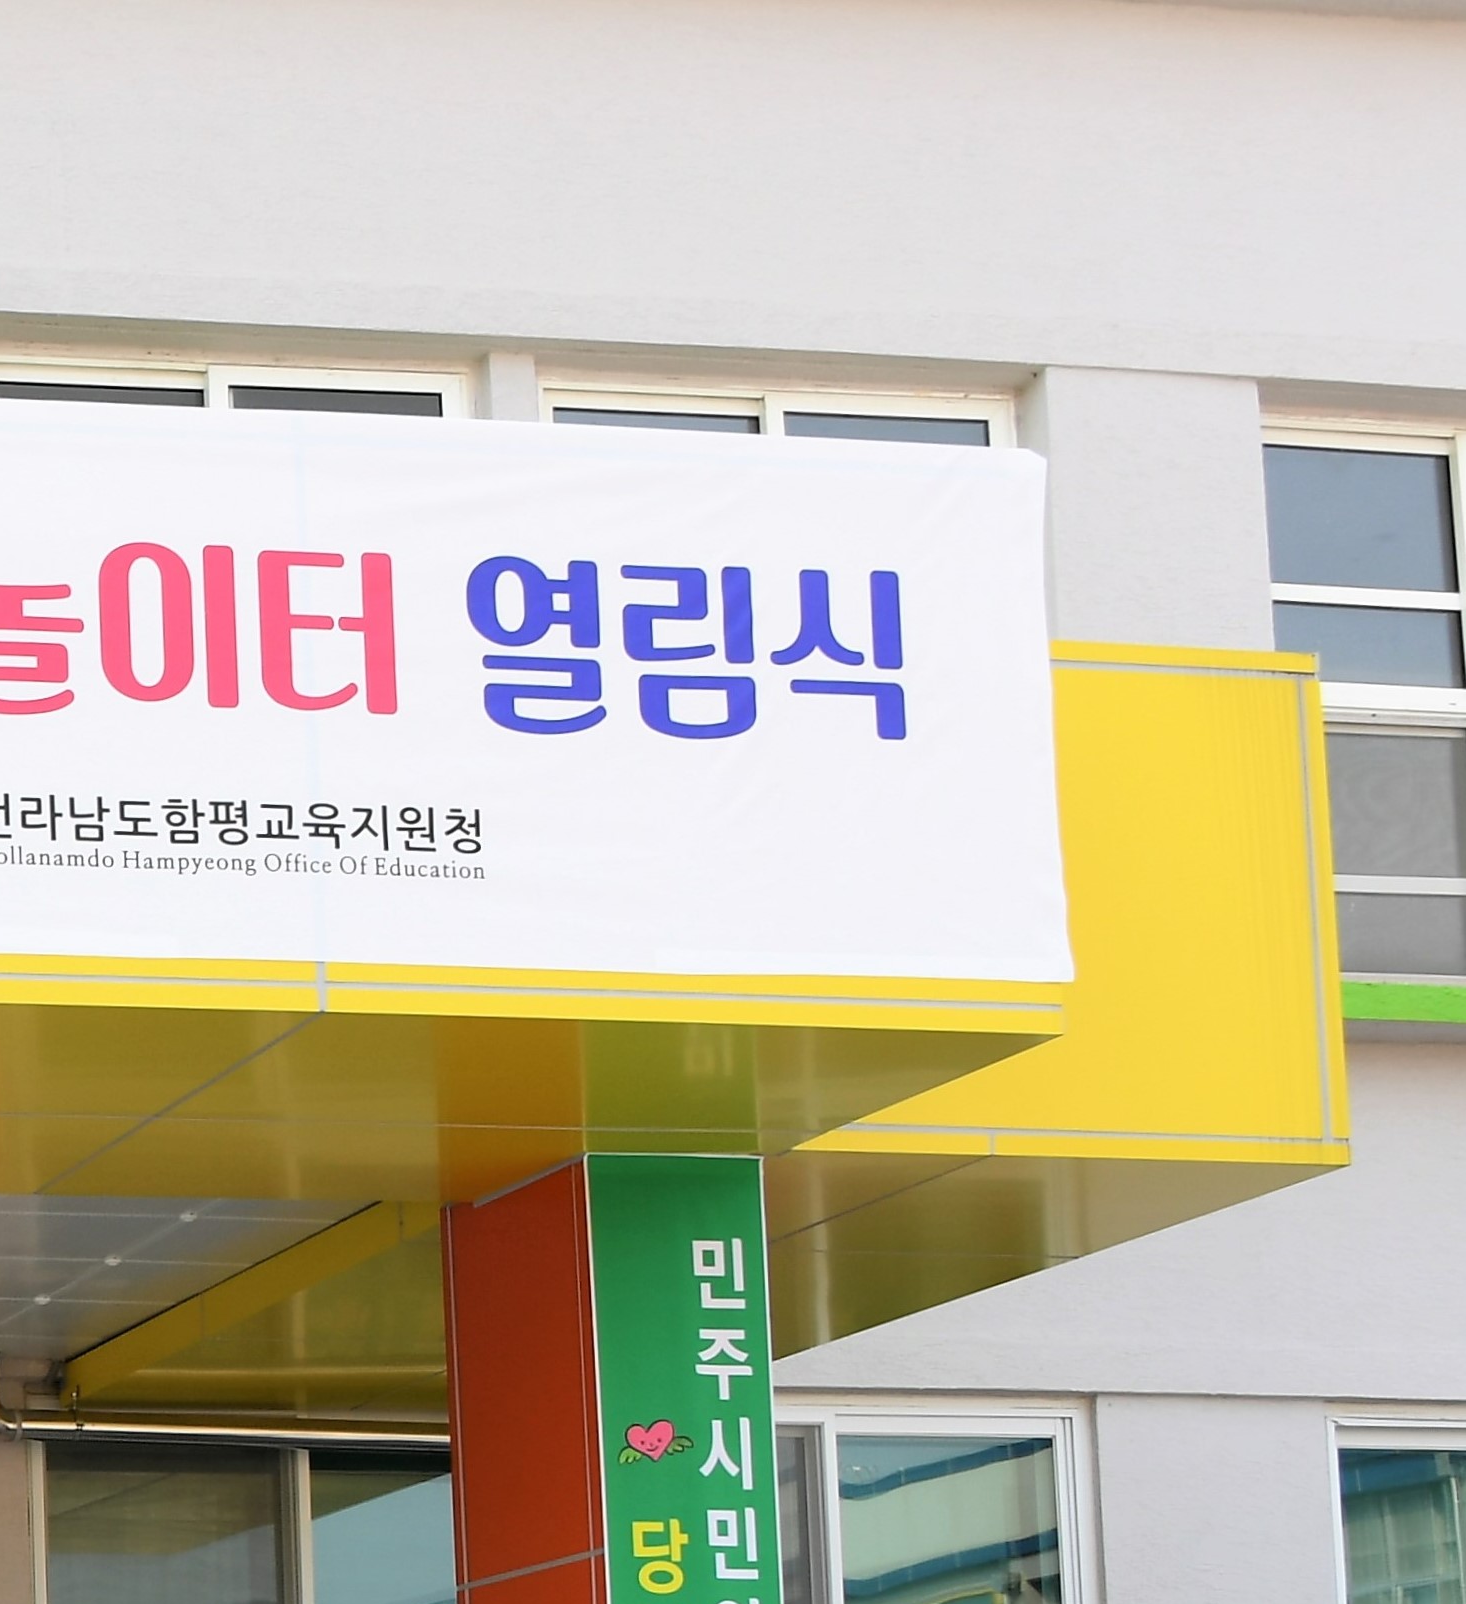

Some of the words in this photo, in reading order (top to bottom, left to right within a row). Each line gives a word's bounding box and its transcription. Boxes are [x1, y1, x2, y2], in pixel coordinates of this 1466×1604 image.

[466, 555, 907, 740] 열림식
[122, 850, 257, 876] Hampyeong
[263, 853, 332, 874] Office
[339, 855, 369, 875] Of
[374, 857, 485, 880] Education
